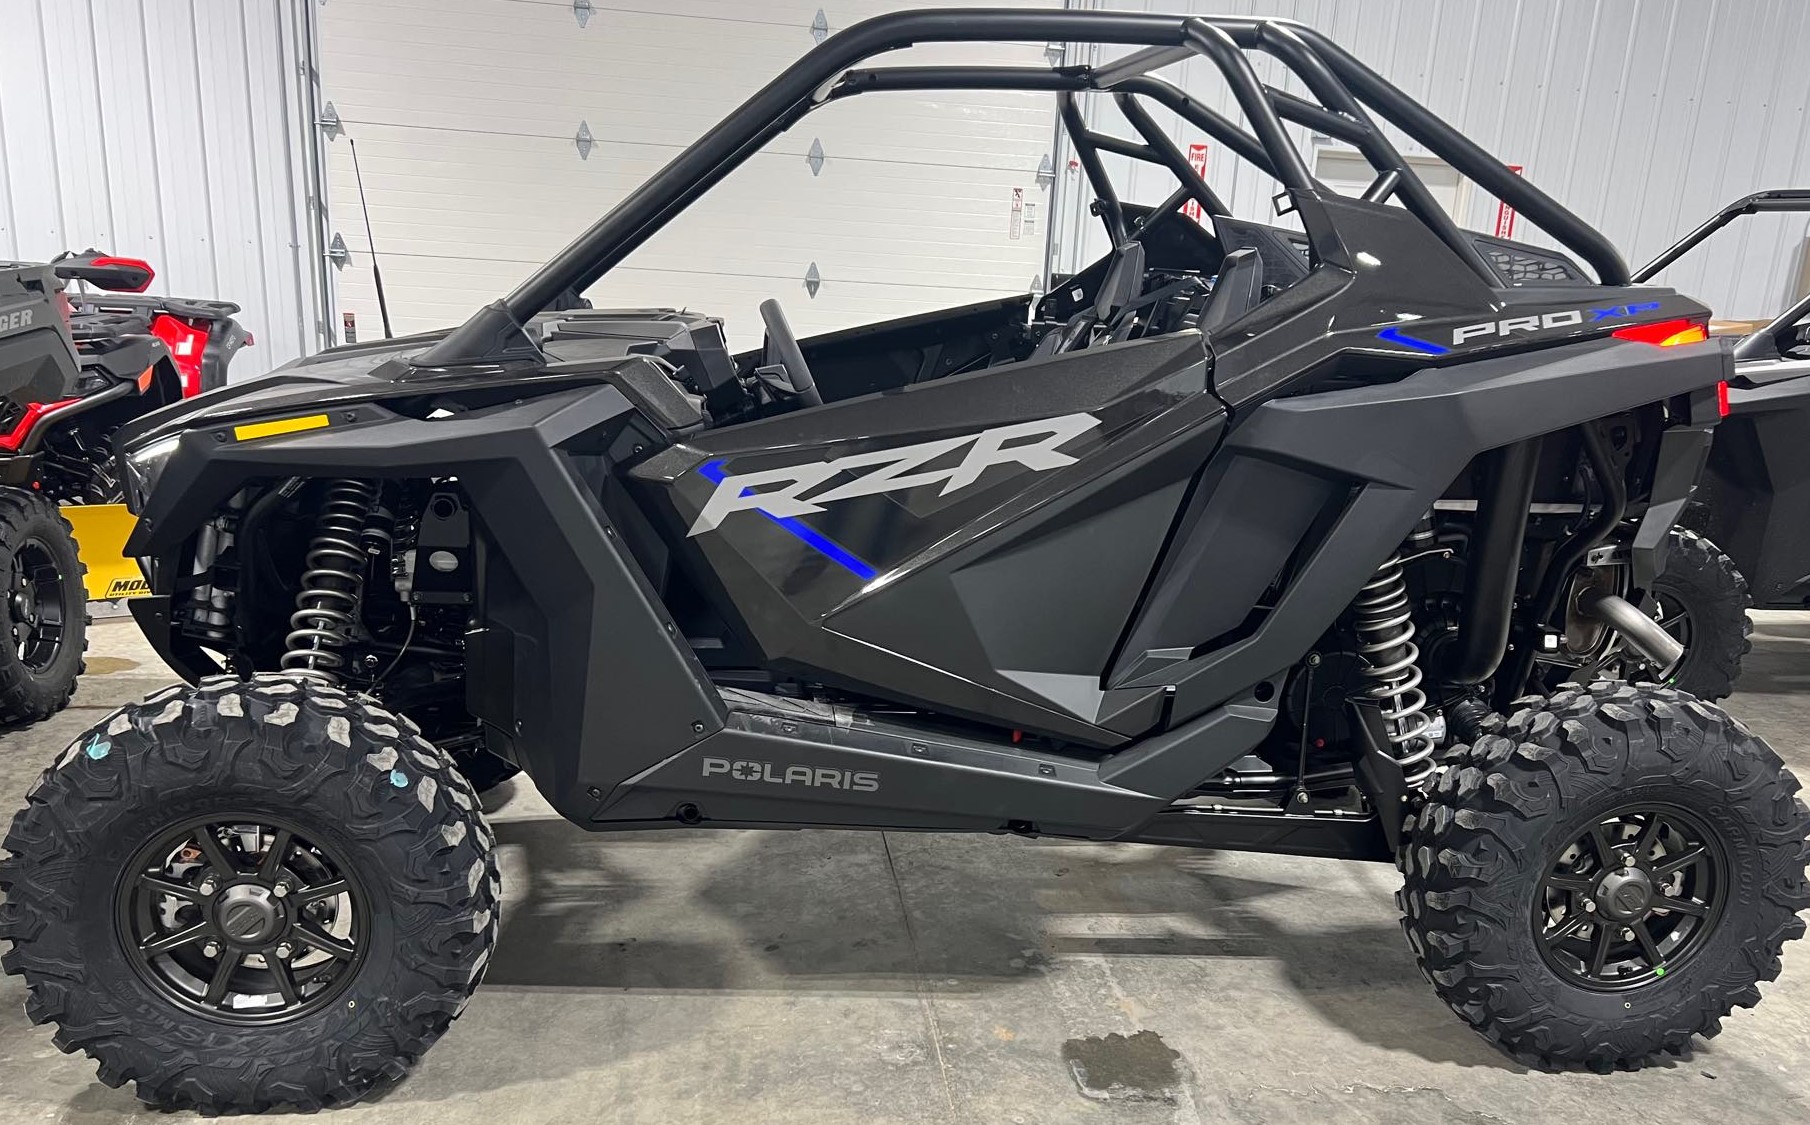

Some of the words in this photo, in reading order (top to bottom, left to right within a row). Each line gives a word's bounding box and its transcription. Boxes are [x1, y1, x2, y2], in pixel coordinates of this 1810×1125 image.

[1191, 152, 1205, 162] FIRE
[0, 309, 33, 332] GER
[1453, 310, 1583, 345] PRO
[1588, 302, 1660, 322] XP
[686, 412, 1102, 538] RZR
[702, 757, 880, 792] POLARIS
